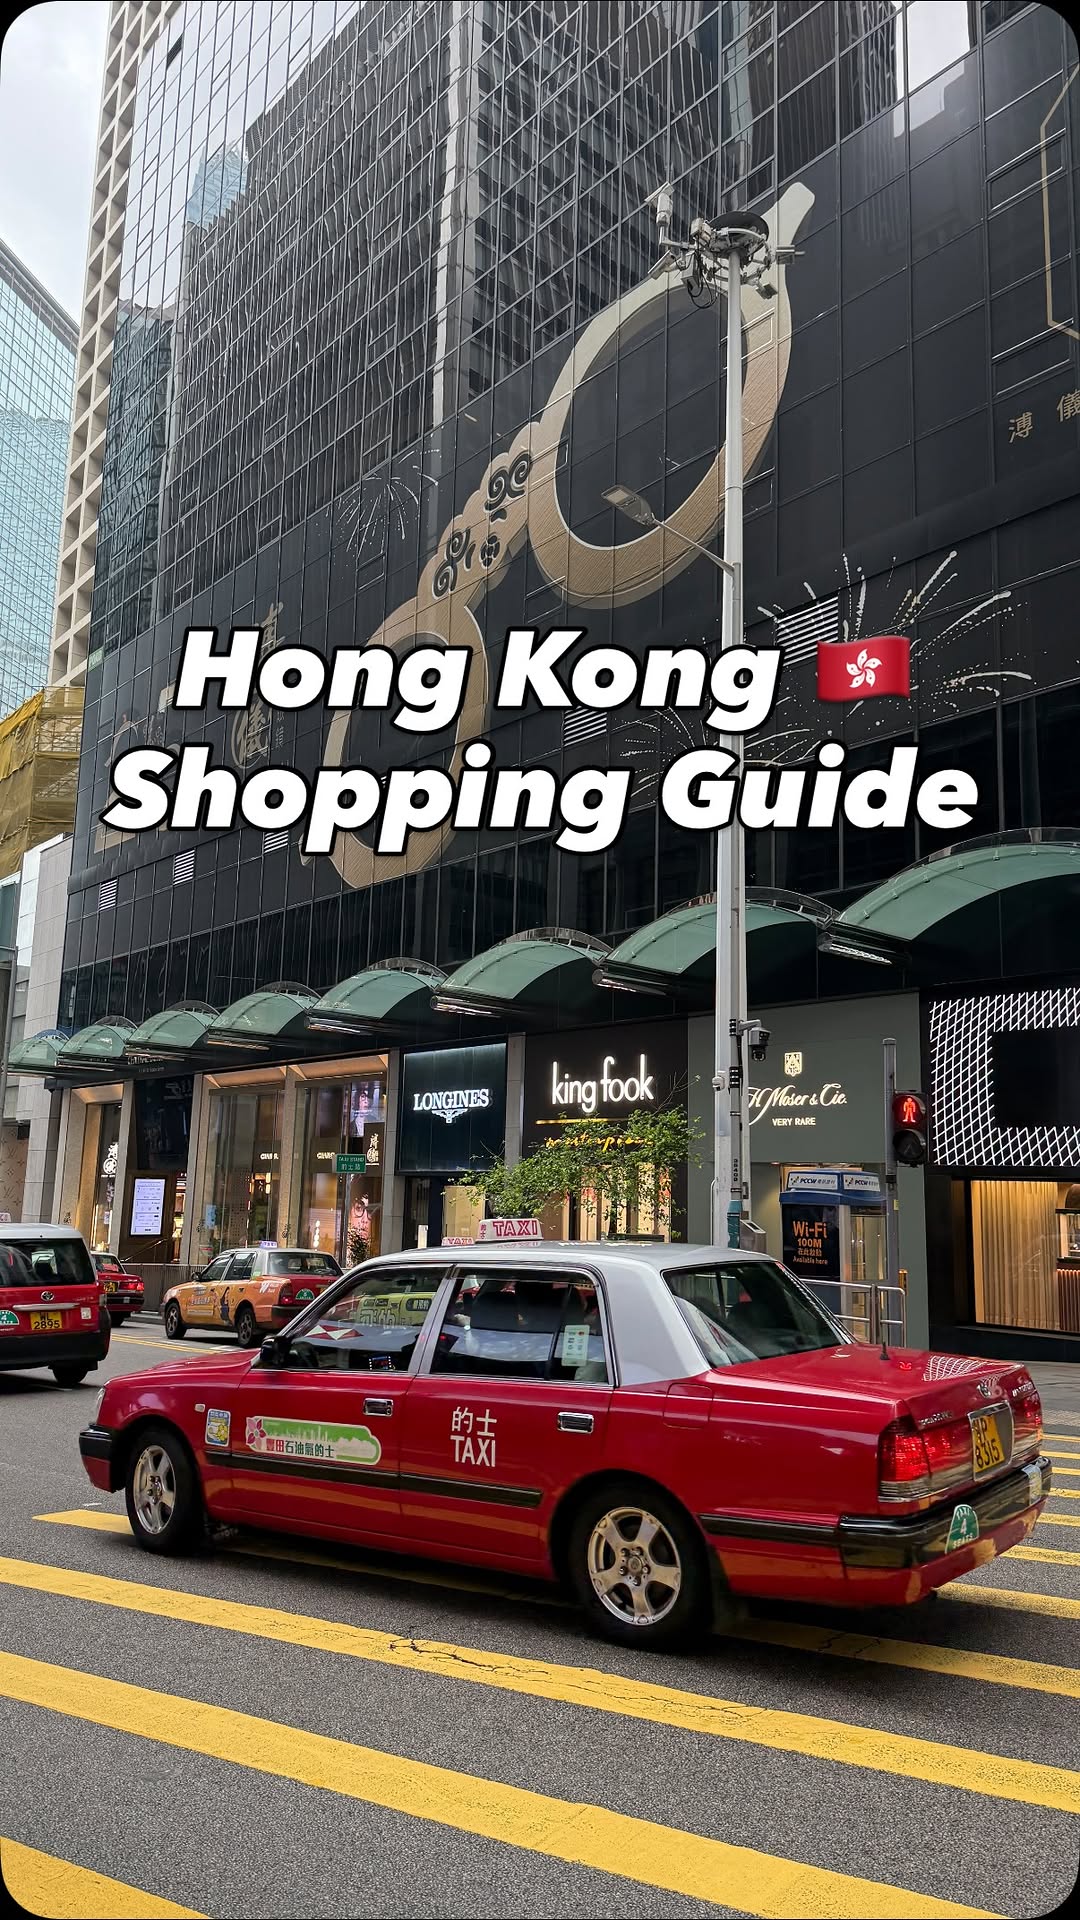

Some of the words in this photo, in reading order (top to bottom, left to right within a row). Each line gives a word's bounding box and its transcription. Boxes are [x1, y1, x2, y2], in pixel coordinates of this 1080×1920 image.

[551, 1061, 598, 1113] king
[600, 1053, 655, 1102] fook
[413, 1088, 490, 1111] LONGINES
[748, 1085, 809, 1126] Moser
[820, 1083, 848, 1107] Cie.
[772, 1118, 793, 1126] VERY
[794, 1117, 816, 1126] RARE
[492, 1220, 538, 1237] TAXI
[792, 1220, 828, 1239] Wi-Fi
[797, 1238, 822, 1249] 100M
[815, 1257, 829, 1265] here
[33, 1320, 61, 1330] 2895
[451, 1406, 497, 1437] 的士
[450, 1435, 496, 1468] TAXI
[975, 1438, 1000, 1469] 8315
[956, 1506, 970, 1520] TAXI
[960, 1518, 967, 1534] 4
